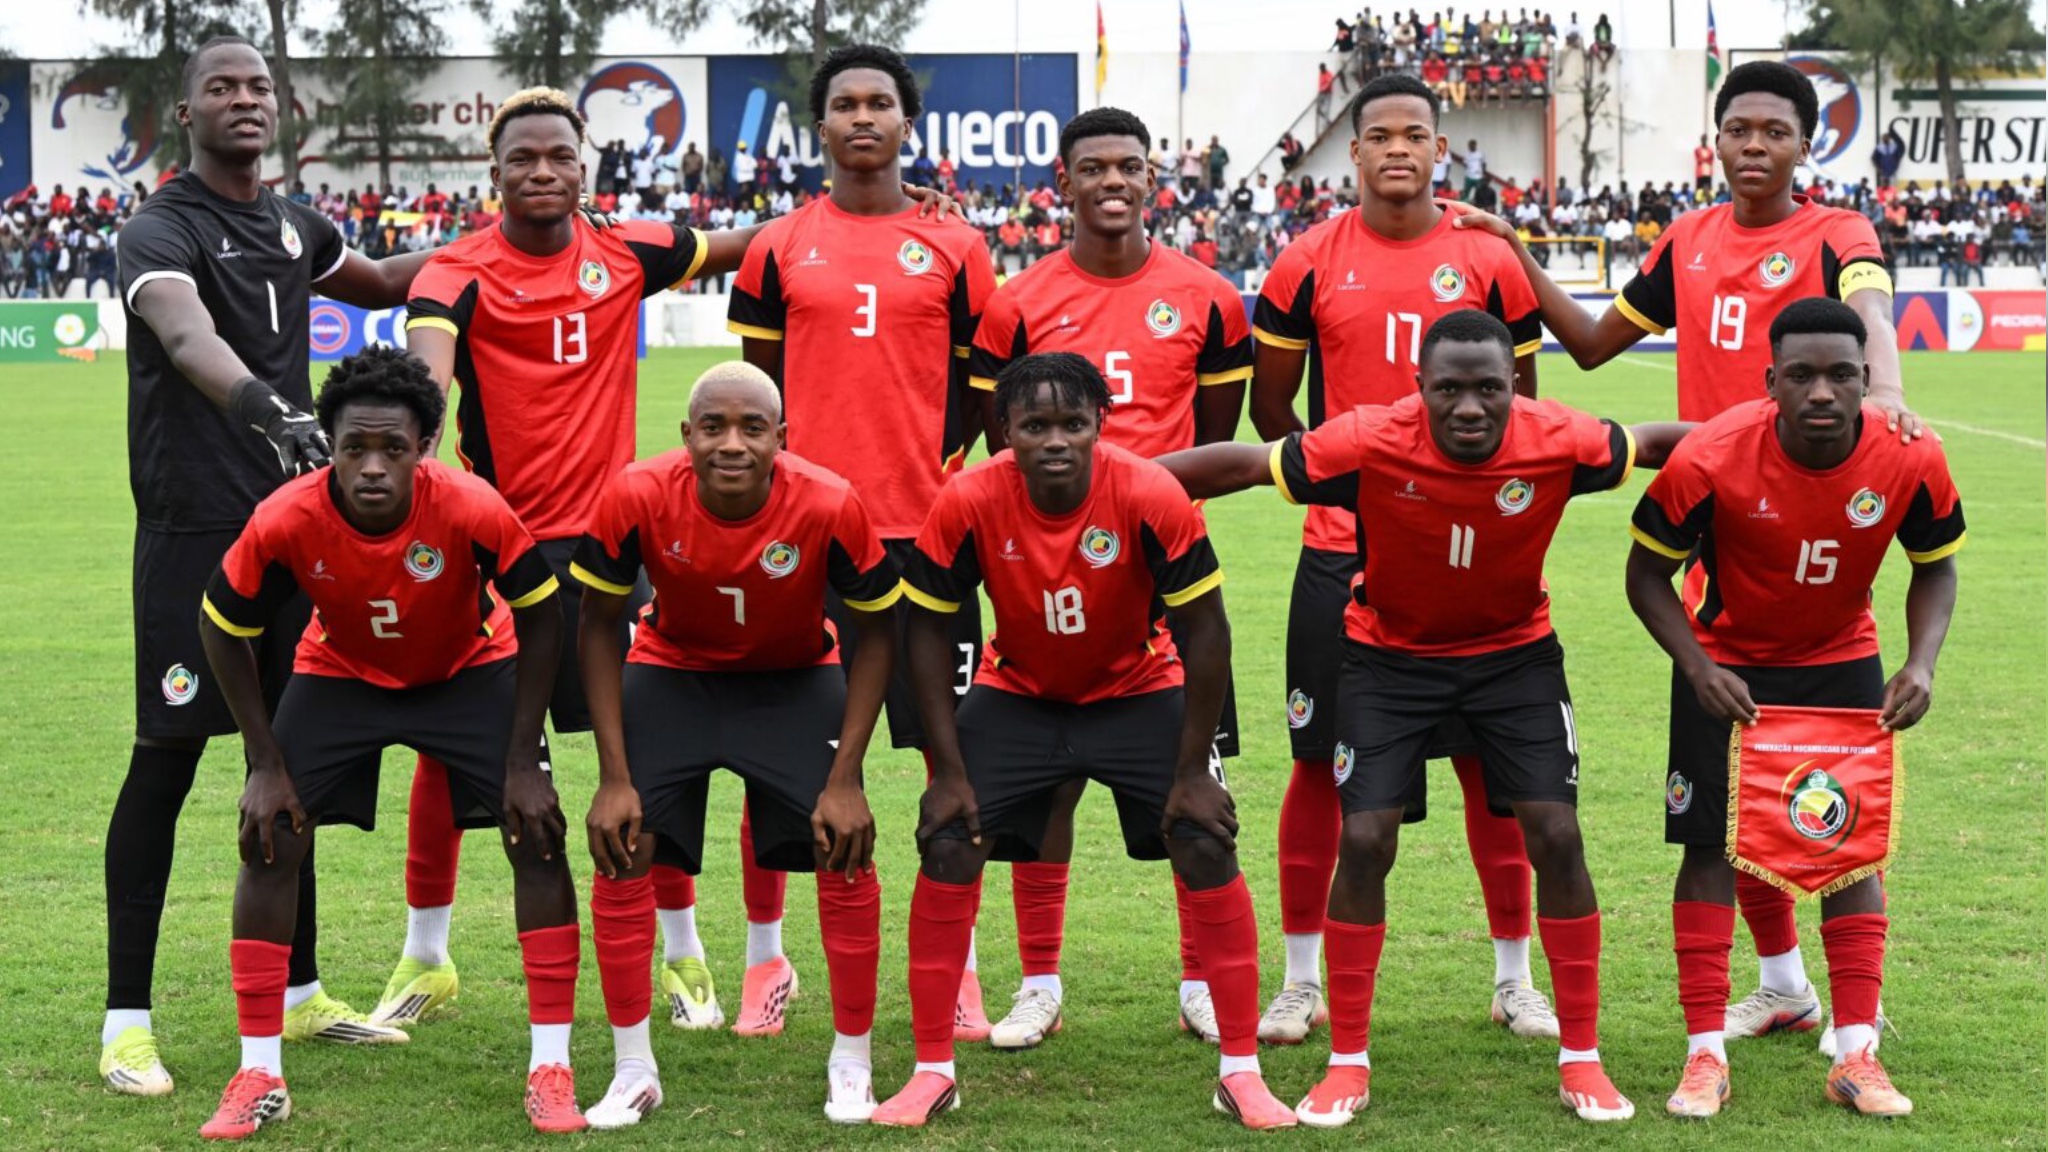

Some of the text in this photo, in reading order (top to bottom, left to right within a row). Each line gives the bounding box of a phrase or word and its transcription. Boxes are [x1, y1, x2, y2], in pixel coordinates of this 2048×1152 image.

[454, 92, 502, 125] ch
[2001, 116, 2046, 164] ST
[266, 280, 279, 334] 1
[851, 283, 877, 337] 3
[1710, 294, 1748, 351] 19
[1, 326, 35, 348] NG
[553, 312, 588, 364] 13
[1385, 311, 1422, 367] 17
[1105, 350, 1133, 404] 5
[1449, 523, 1475, 570] 11
[1794, 539, 1841, 585] 15
[367, 599, 404, 638] 2
[715, 586, 745, 626] 7
[1043, 585, 1086, 635] 18
[953, 642, 974, 695] 3
